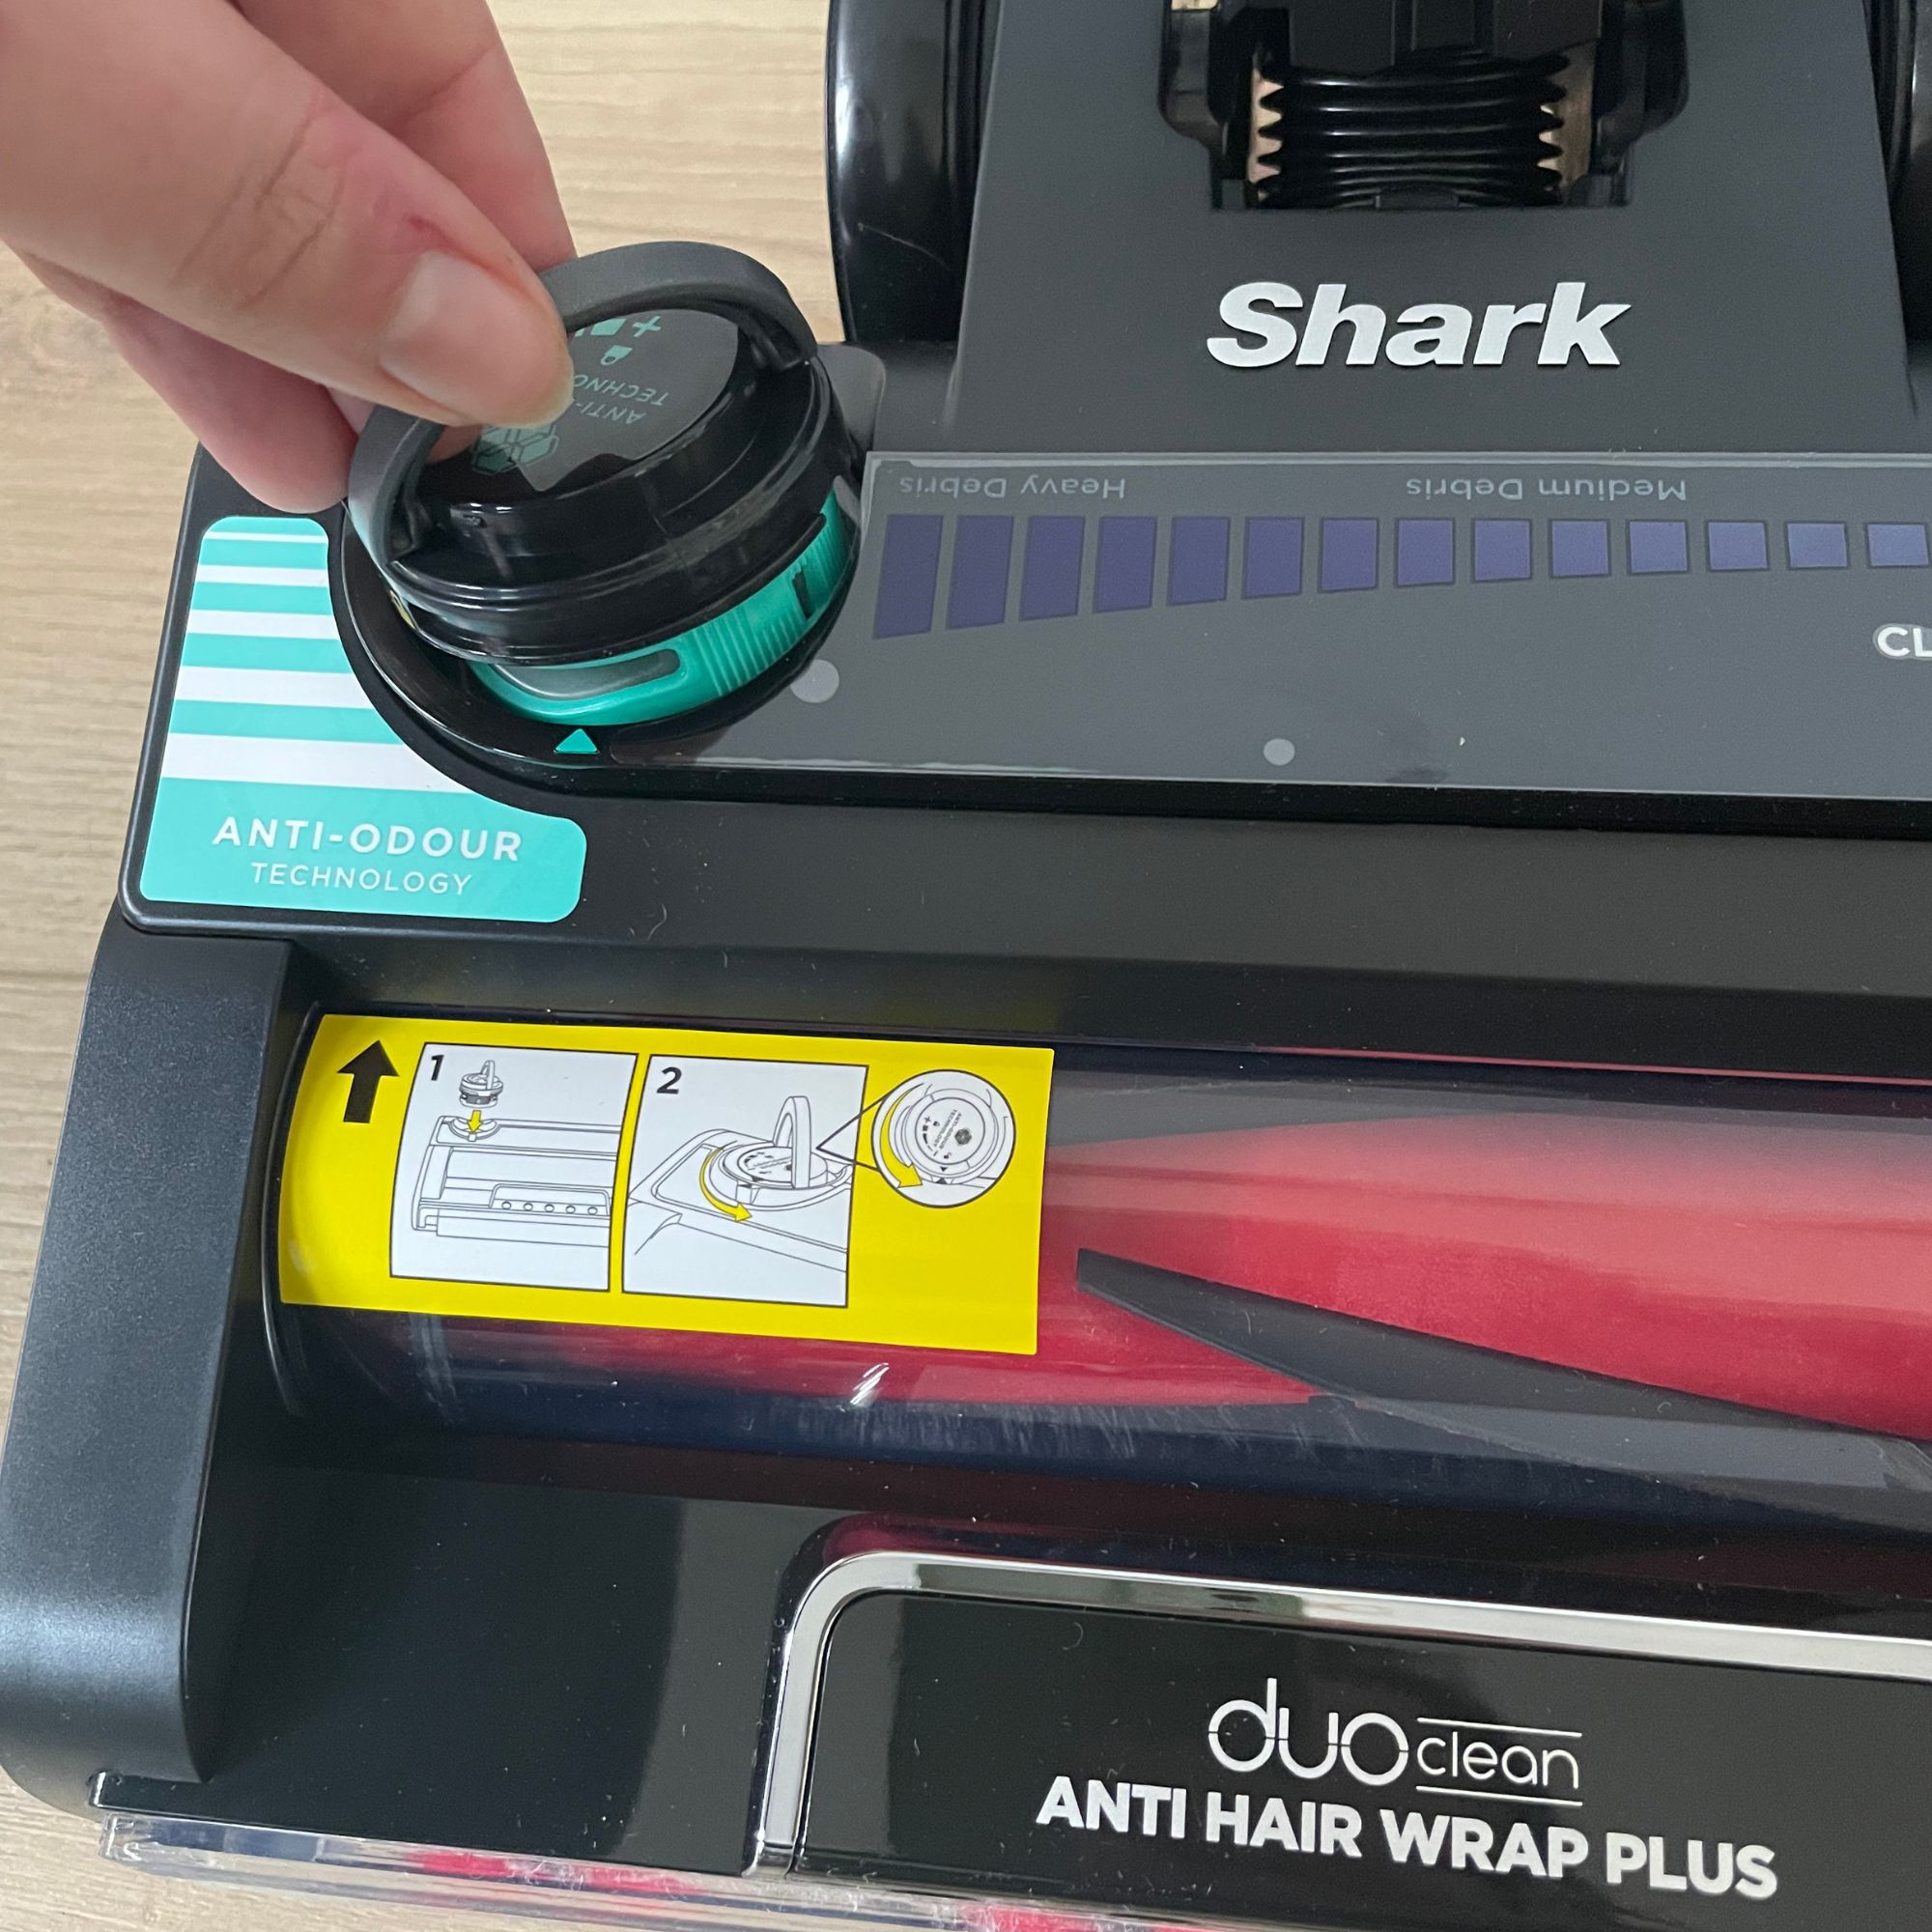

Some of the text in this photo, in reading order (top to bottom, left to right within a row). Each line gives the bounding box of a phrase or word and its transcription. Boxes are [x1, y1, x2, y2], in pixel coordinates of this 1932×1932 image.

[1207, 281, 1632, 367] Shark
[573, 374, 669, 407] TECHNO
[575, 401, 647, 425] ANTI-
[899, 473, 1126, 499] Heavy Debris
[1406, 477, 1687, 501] Medium Debris
[1877, 626, 1932, 657] CL
[212, 816, 523, 862] ANTI-ODOUR
[250, 861, 473, 895] TECHNOLOGY
[430, 1054, 444, 1081] 1
[656, 1066, 682, 1094] 2
[1036, 1776, 1778, 1901] ANTI HAIR WRAP PLUS
